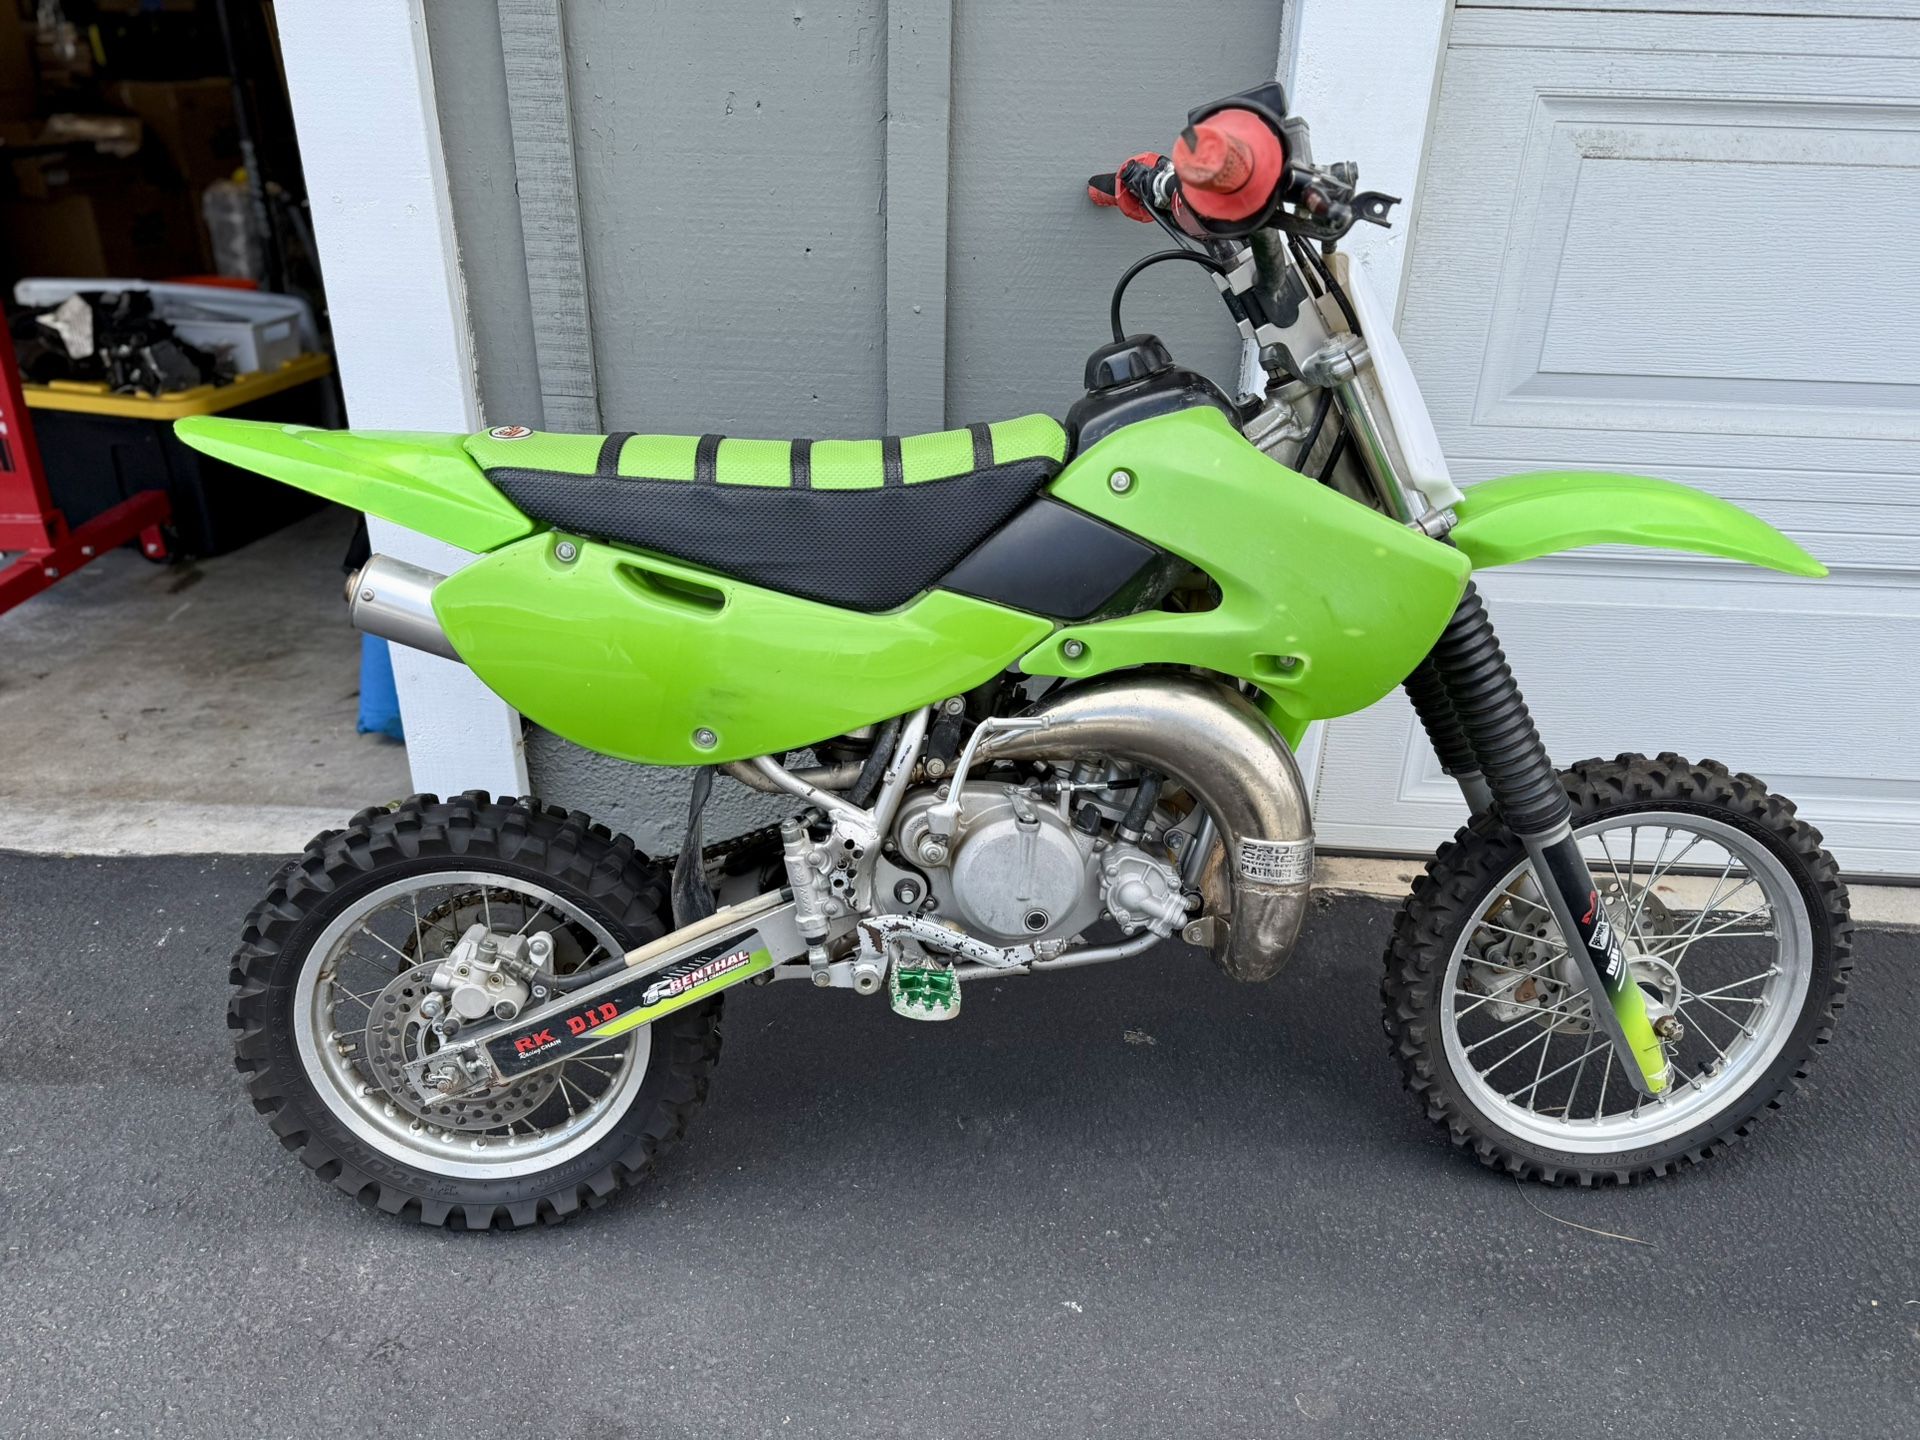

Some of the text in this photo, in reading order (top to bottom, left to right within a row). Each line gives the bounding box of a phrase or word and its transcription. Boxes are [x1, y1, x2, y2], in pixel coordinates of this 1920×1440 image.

[669, 950, 750, 991] RENTHAL
[514, 1028, 556, 1052] RK
[518, 1039, 562, 1059] Racing CHAIN
